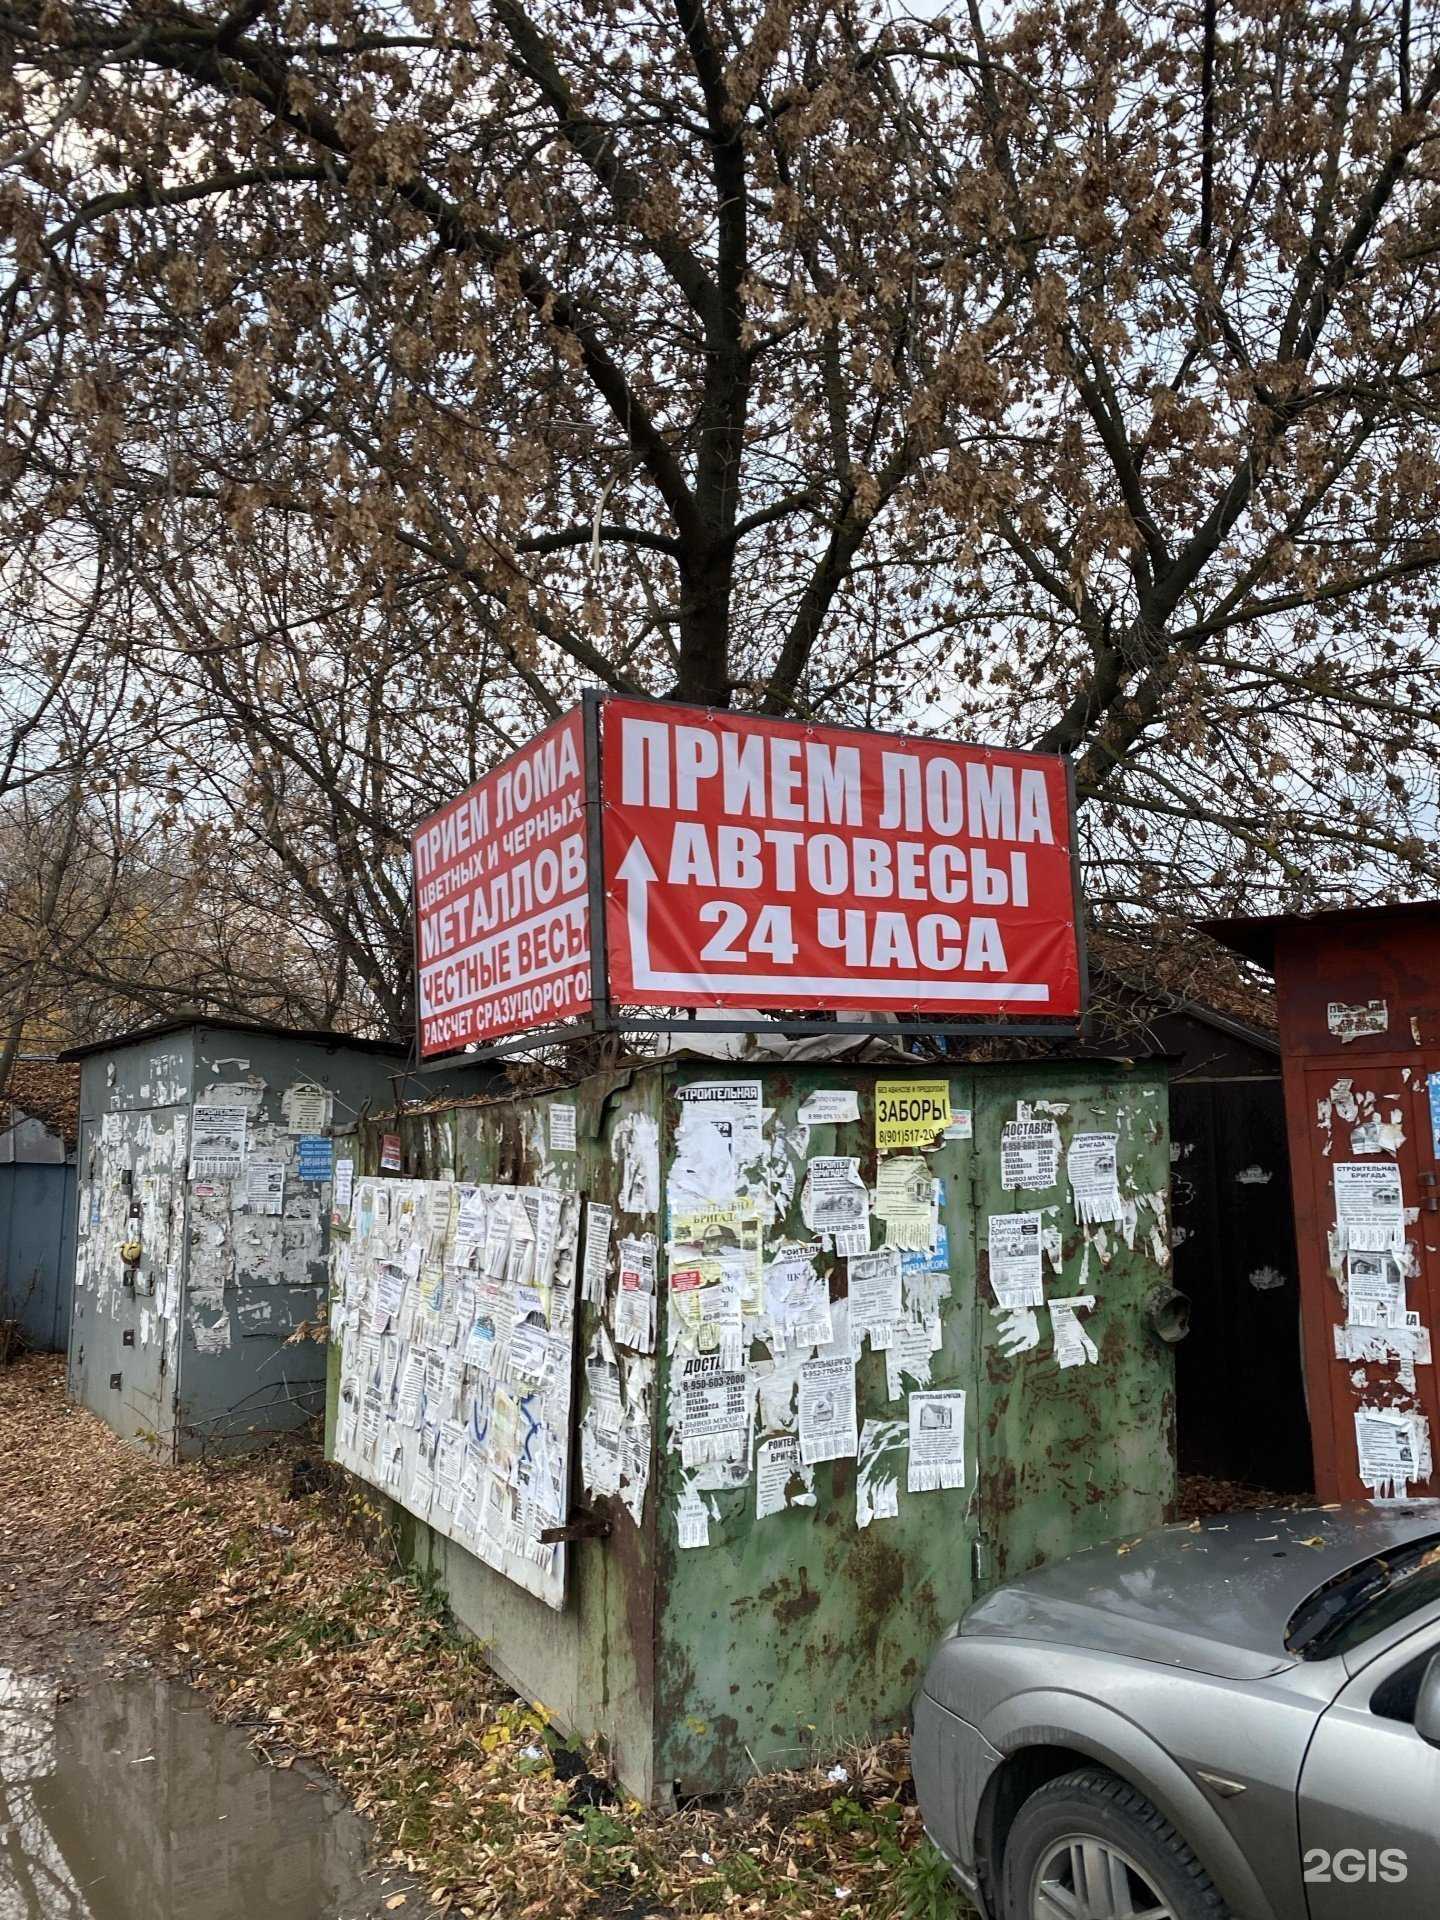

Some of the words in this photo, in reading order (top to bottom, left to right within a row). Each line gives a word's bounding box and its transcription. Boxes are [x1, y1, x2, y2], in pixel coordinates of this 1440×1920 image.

[415, 789, 488, 879] ПРИЕМ
[495, 727, 581, 829] ЛОМА
[621, 717, 862, 827] ПРИЕМ
[879, 751, 1054, 845] ЛОМА
[418, 852, 484, 913] ЦВЕТНЫХ
[487, 841, 499, 870] И
[503, 788, 582, 858] ЧЕРНЫХ
[667, 821, 1029, 908] АВТОВЕСЫ
[421, 832, 588, 962] МЕТАЛЛОВ
[700, 901, 799, 965] 24
[817, 907, 1009, 973] ЧАСА
[422, 941, 511, 1020] ЧЕСТНЫЕ
[423, 1008, 473, 1047] РАССЧЕТ
[878, 1098, 947, 1123] ЗАБОРЫ
[1003, 1122, 1052, 1138] ДОСТАВКА
